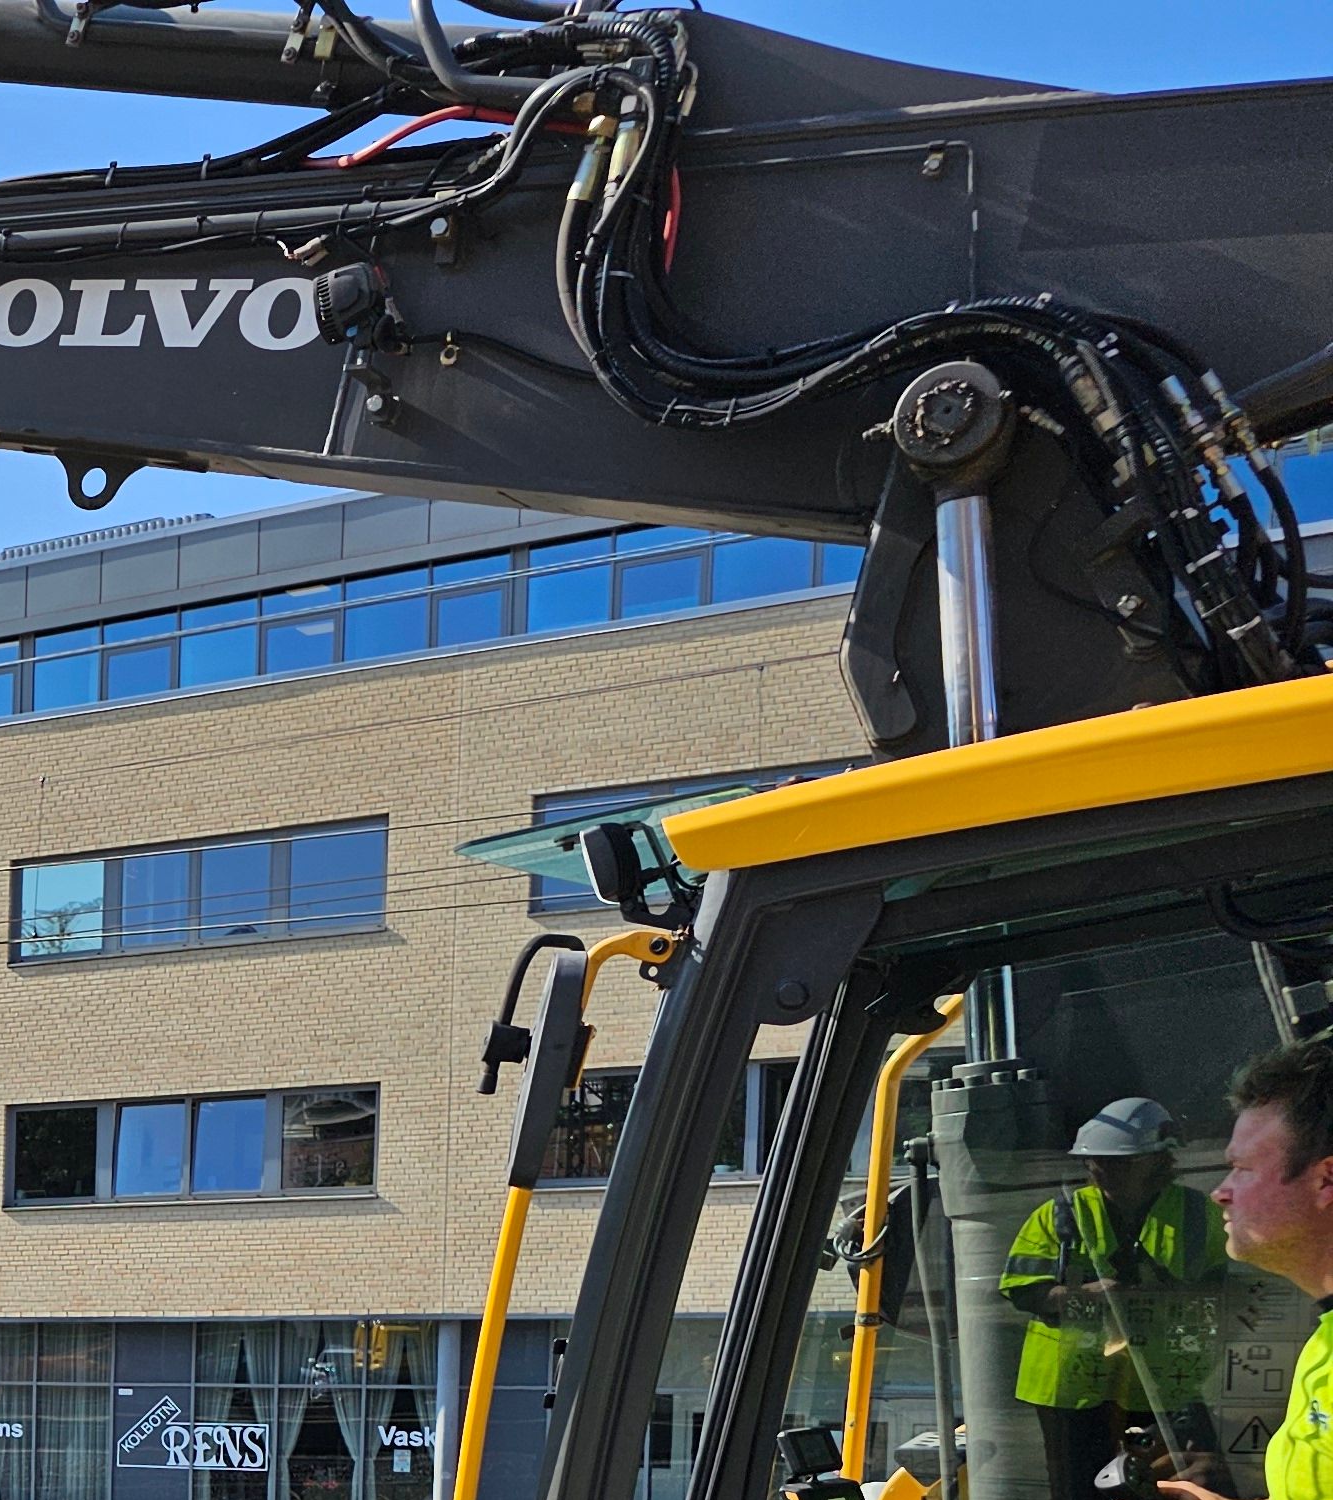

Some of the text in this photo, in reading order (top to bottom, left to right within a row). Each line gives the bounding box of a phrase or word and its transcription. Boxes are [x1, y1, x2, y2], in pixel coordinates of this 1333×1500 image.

[120, 1401, 177, 1453] KOLBOTN
[161, 1425, 265, 1468] RENS
[377, 1425, 436, 1447] Vask
